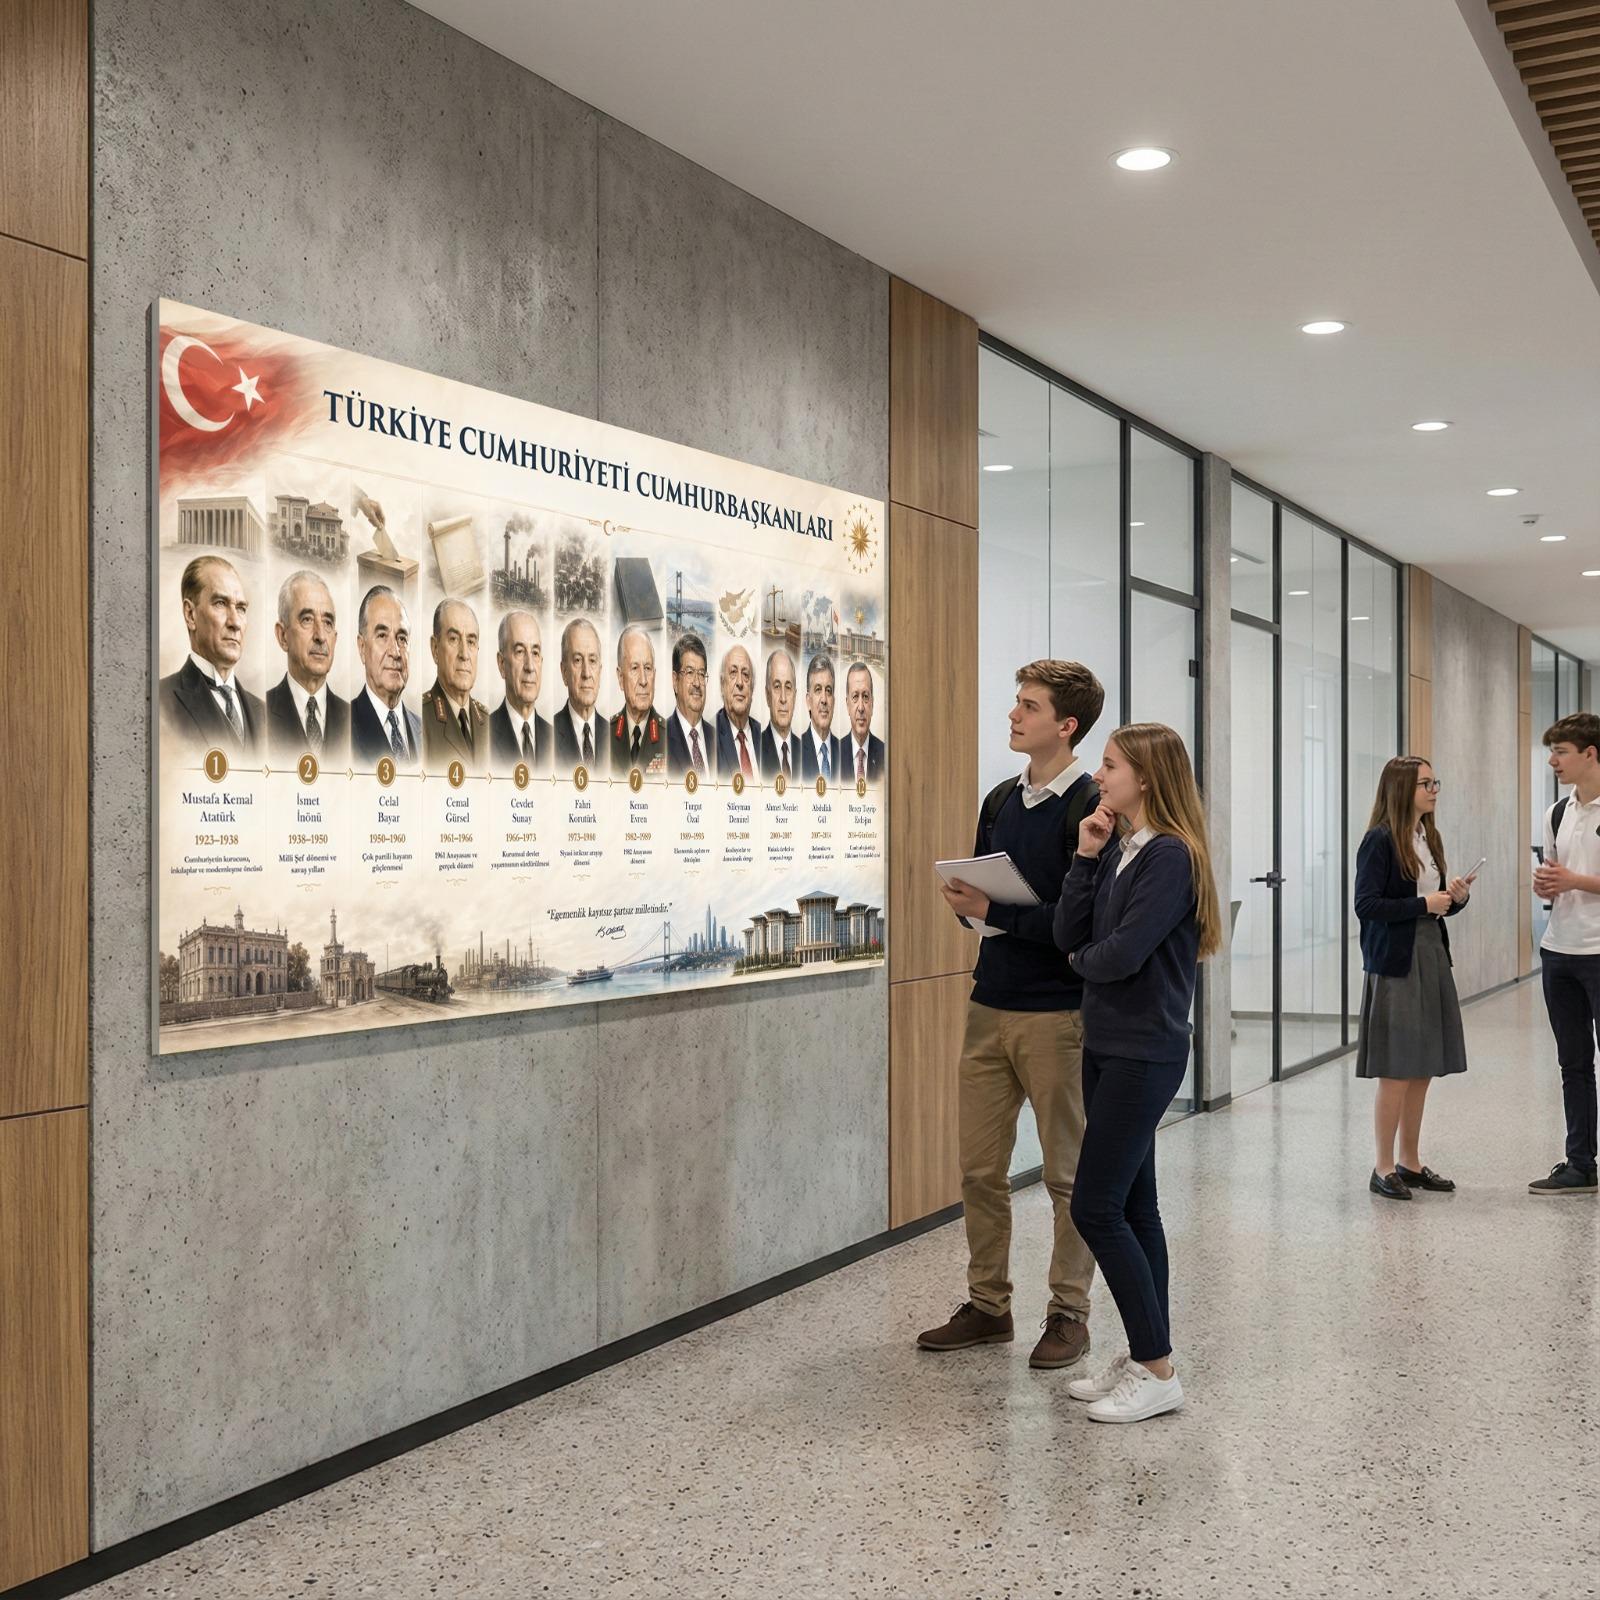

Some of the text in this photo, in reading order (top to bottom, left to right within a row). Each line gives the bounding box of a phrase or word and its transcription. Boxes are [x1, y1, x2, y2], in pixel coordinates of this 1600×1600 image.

[323, 390, 834, 541] TÜRKİYE CUMHURİYETİ CUMHURBAŞKANLARI
[304, 760, 312, 778] 2
[382, 762, 390, 780] 3
[452, 766, 460, 782] 4
[518, 767, 525, 784] 5
[578, 770, 584, 786] 6
[633, 772, 639, 787] 7
[776, 777, 785, 792] 10
[818, 779, 824, 793] 11
[858, 780, 865, 794] 12
[182, 792, 253, 805] Mustafa Kemal
[297, 792, 319, 806] İsmet
[378, 795, 399, 807] Celal
[446, 797, 469, 808] Cemal
[510, 798, 534, 809] Cevdet
[575, 800, 591, 809] Fahri
[629, 800, 649, 810] Kenan
[684, 801, 702, 812] Turgut
[200, 810, 236, 822] Atatürk
[297, 809, 322, 823] İnönü
[378, 812, 400, 824] Bayar
[445, 812, 470, 823] Gürsel
[512, 813, 532, 825] Sunay
[569, 813, 597, 823] Korutürk
[630, 814, 648, 824] Evren
[686, 812, 700, 824] Özal
[729, 815, 750, 824] Demirel
[195, 834, 239, 845] 1923–1938
[288, 834, 329, 844] 1938–1950
[369, 833, 406, 843] 1950–1960
[440, 833, 473, 843] 1961–1966
[506, 833, 537, 842] 1966–1973
[294, 854, 305, 863] Şef
[306, 854, 329, 862] dönemi
[362, 852, 374, 862] Çok
[374, 852, 392, 862] partili
[588, 906, 612, 919] kayıtsız
